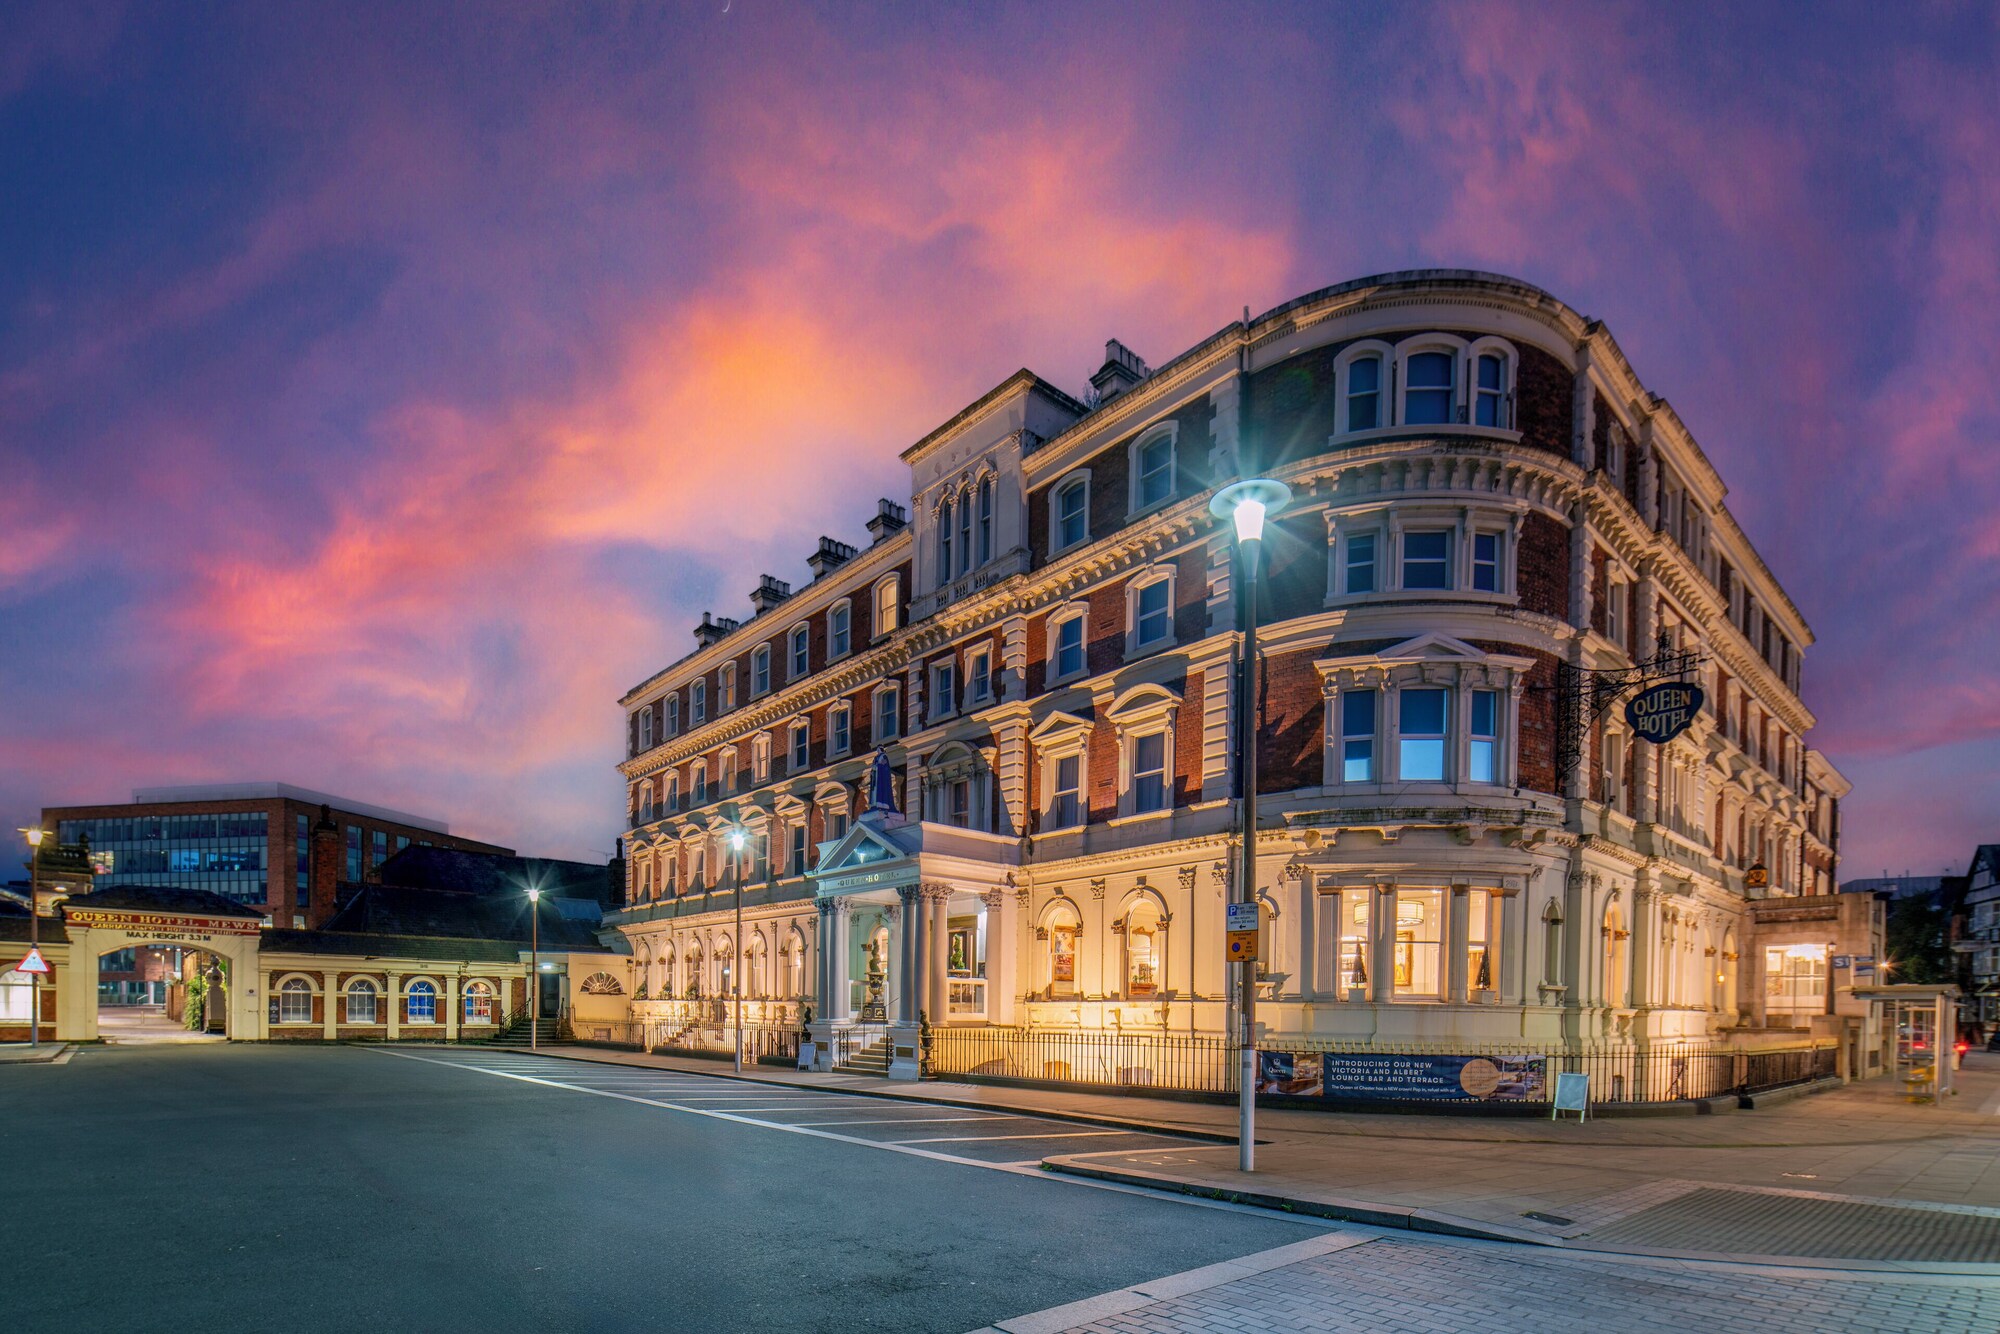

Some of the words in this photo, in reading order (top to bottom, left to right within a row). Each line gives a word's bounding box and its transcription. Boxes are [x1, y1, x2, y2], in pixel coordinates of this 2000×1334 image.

[1633, 689, 1692, 716] QUEEN
[1638, 709, 1690, 737] HOTEL
[72, 911, 132, 922] QUEEN
[140, 915, 199, 926] HOTEL
[208, 920, 255, 930] MEWS
[152, 932, 185, 940] HEIGHT
[1331, 1060, 1390, 1068] INTRODUCING
[1268, 1066, 1286, 1074] Queen
[1331, 1067, 1370, 1075] VICTORIA
[1331, 1074, 1365, 1082] LOUNGE
[1407, 1076, 1444, 1084] TERRACE
